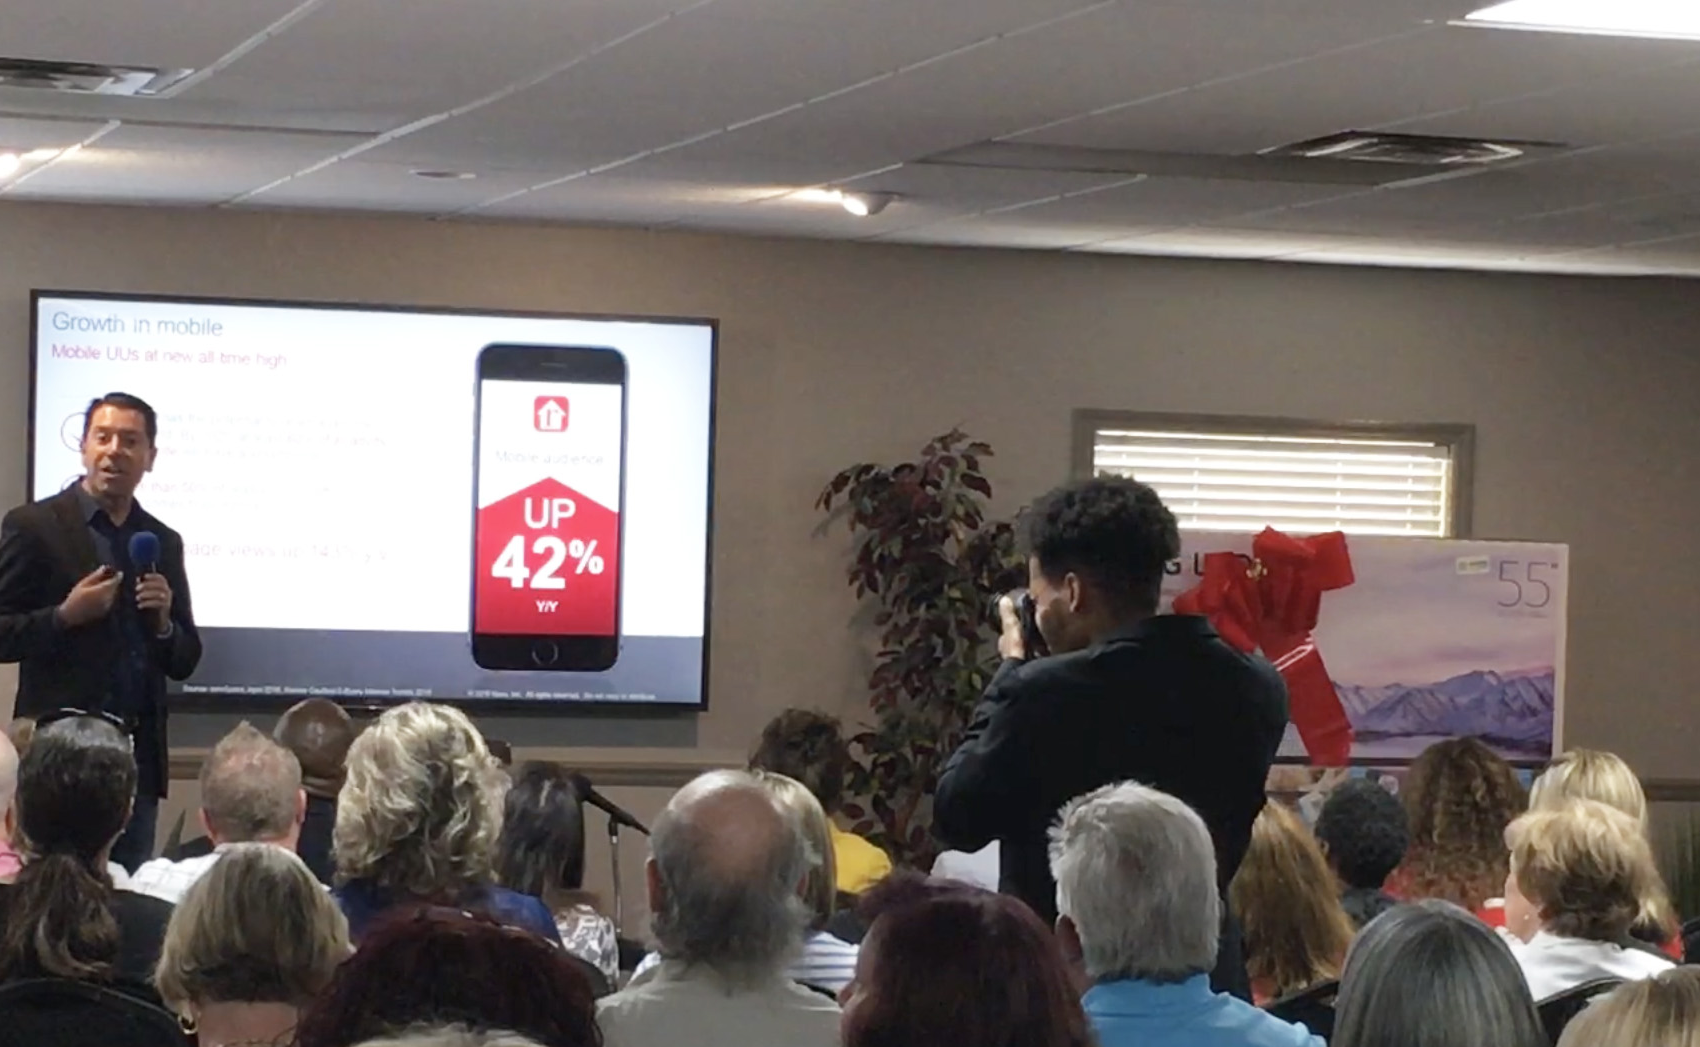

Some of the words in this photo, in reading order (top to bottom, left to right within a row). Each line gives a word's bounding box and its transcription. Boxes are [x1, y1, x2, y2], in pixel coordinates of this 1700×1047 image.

[52, 311, 125, 333] Growth
[133, 316, 152, 334] in
[158, 317, 224, 336] mobile
[51, 344, 101, 361] Mobile
[106, 346, 140, 362] UUs
[145, 348, 159, 362] at
[163, 351, 194, 364] new
[524, 497, 576, 529] UP
[491, 533, 605, 589] 42%
[534, 600, 559, 613] Y/Y
